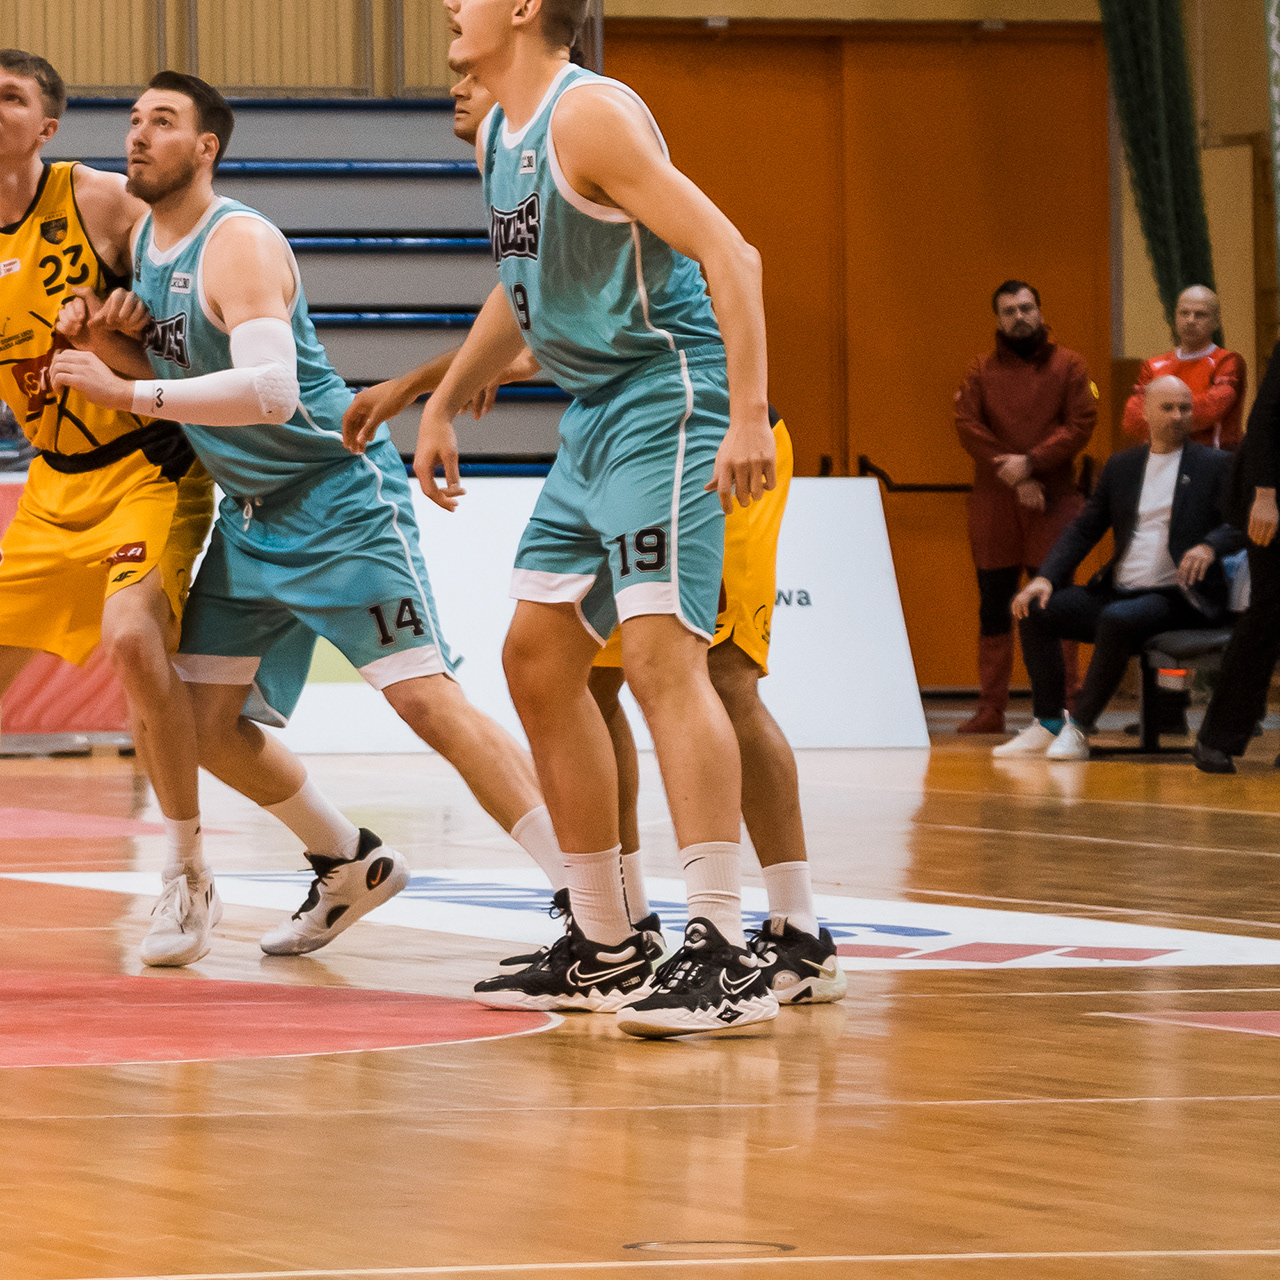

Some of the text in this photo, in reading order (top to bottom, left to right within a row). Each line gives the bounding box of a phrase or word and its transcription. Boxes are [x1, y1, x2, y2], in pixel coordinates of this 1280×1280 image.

[38, 244, 90, 296] 23
[614, 525, 669, 579] 19
[368, 596, 425, 648] 14
